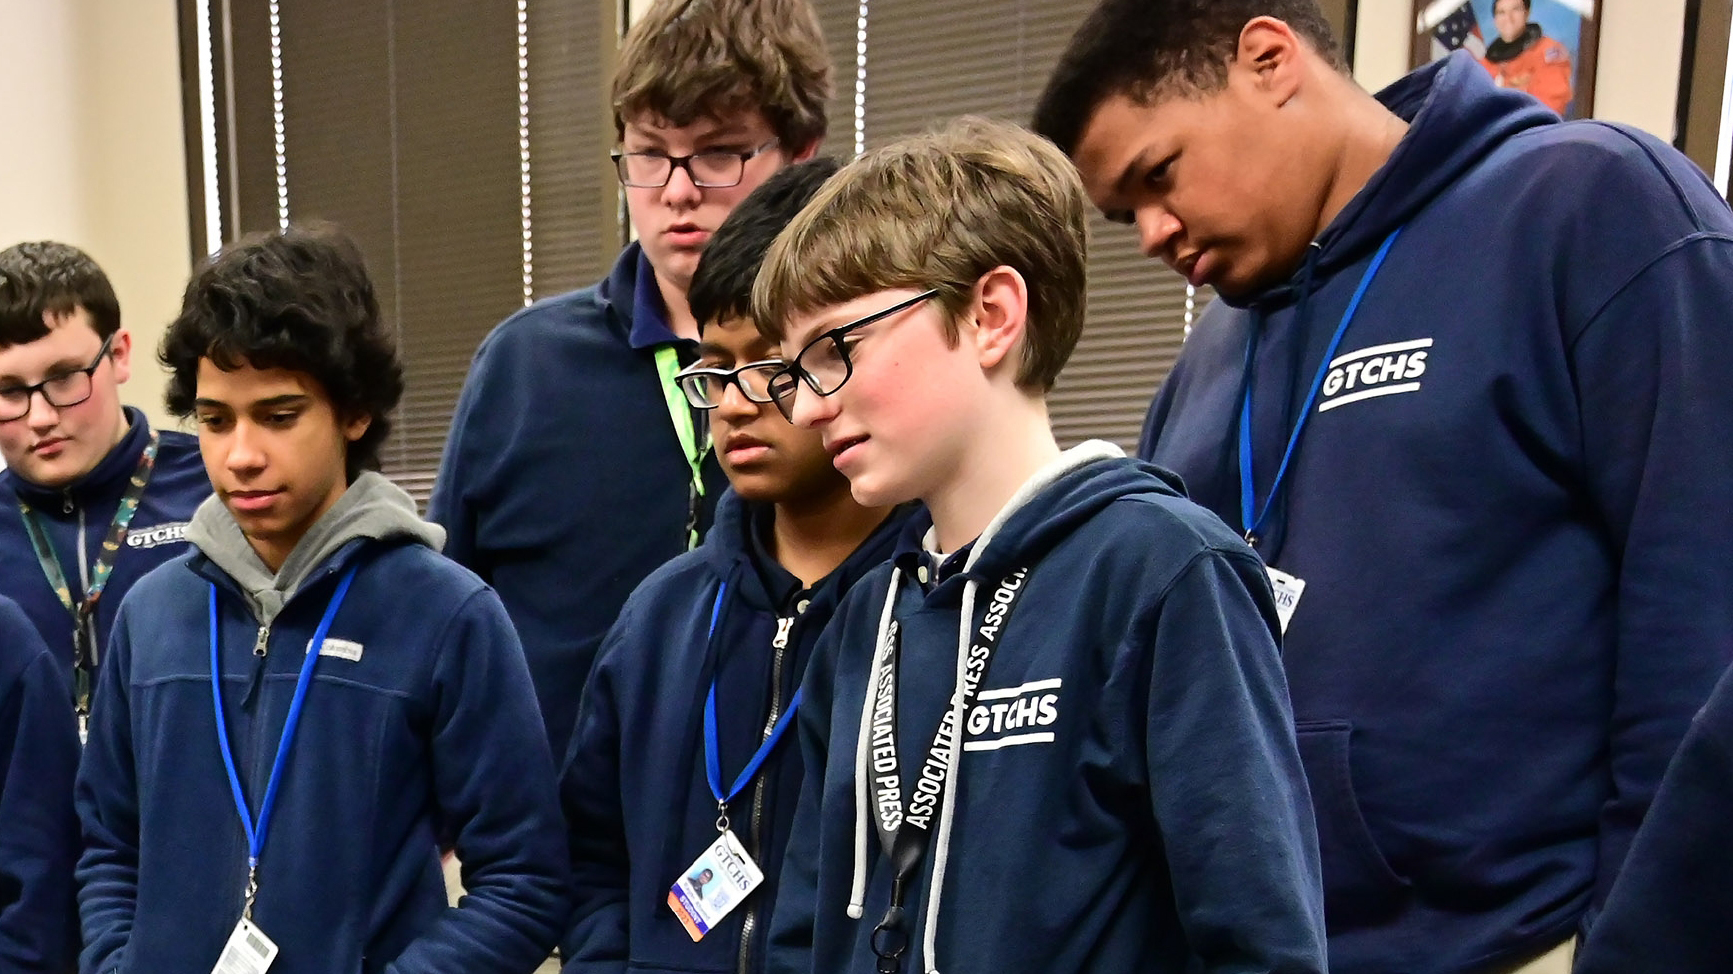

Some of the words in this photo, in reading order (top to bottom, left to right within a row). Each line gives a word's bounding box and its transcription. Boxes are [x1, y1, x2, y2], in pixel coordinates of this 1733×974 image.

[1323, 351, 1428, 397] GTCHS
[872, 664, 897, 773] ASSOCIATED
[967, 693, 1059, 736] GTCHS
[875, 775, 903, 832] PRESS
[714, 844, 750, 891] GTCHS
